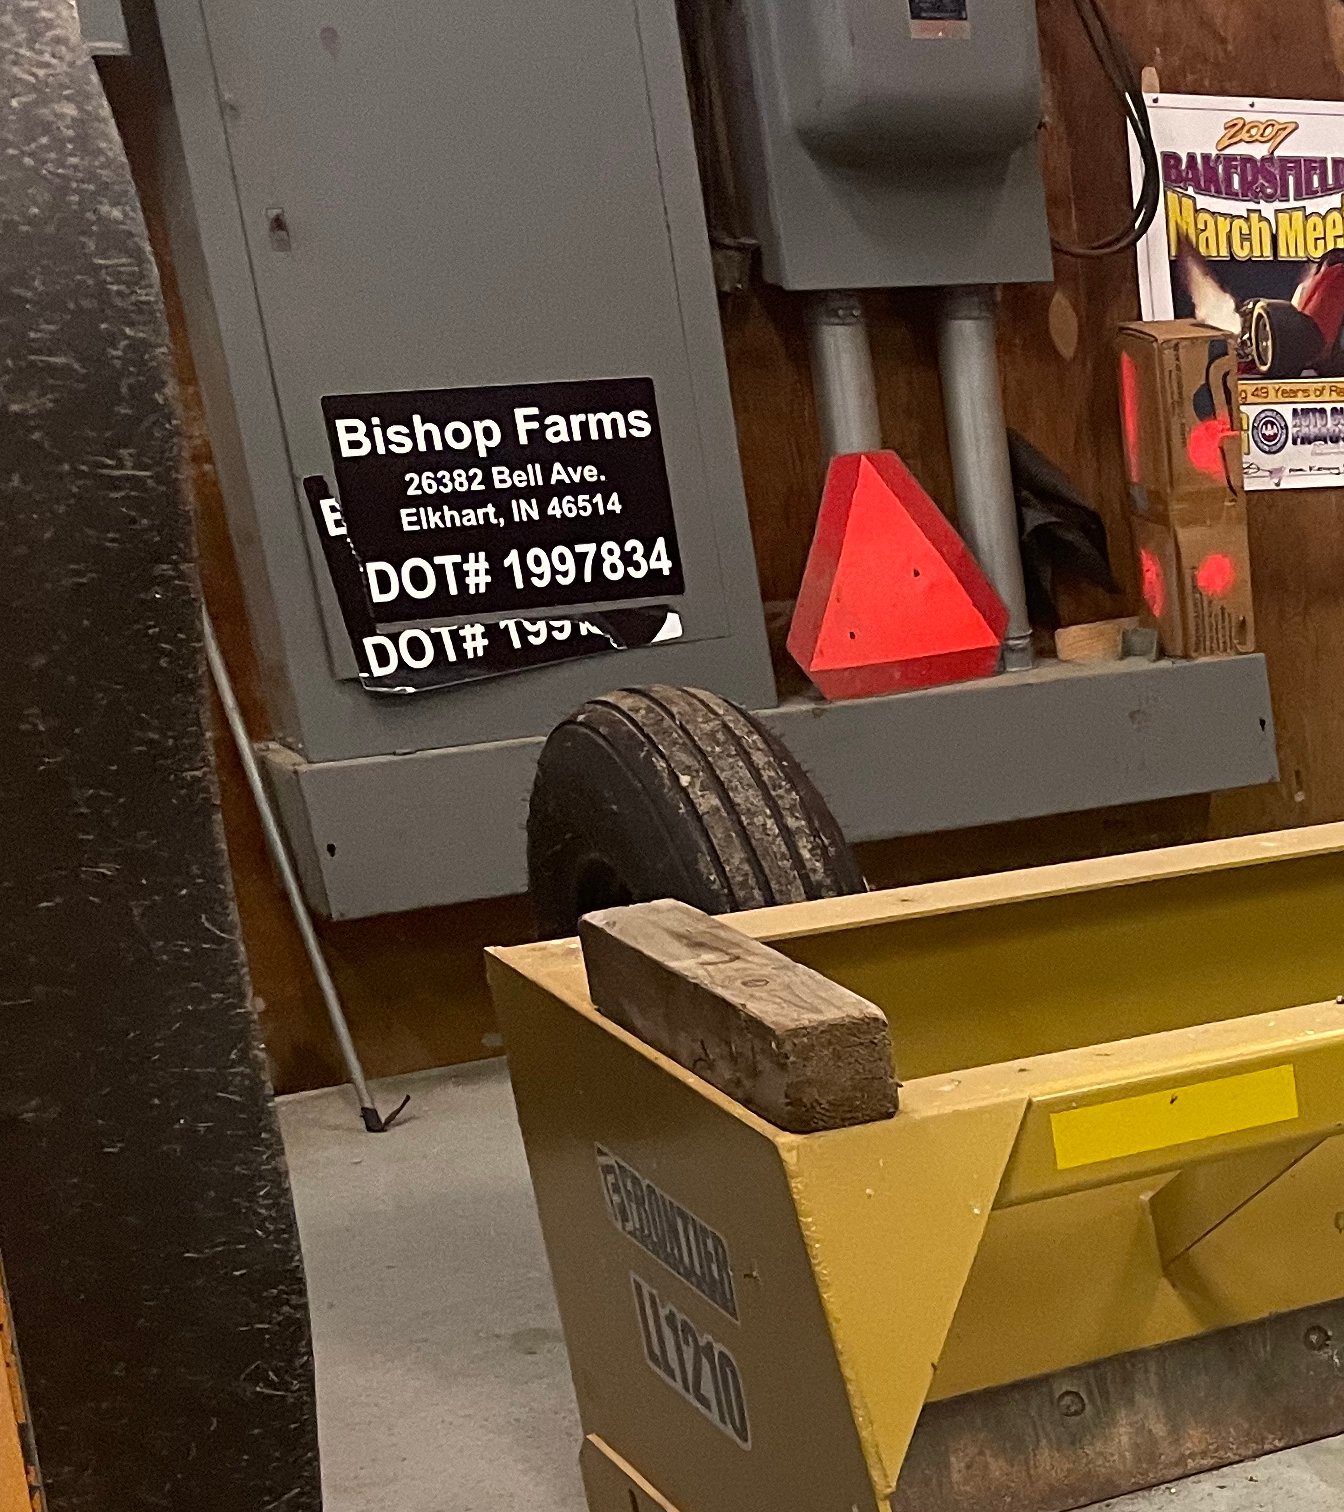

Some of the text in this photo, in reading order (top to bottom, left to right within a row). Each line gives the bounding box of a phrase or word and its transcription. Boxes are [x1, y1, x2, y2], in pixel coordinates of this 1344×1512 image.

[1216, 117, 1299, 154] 2007
[1165, 188, 1273, 261] March
[1251, 386, 1269, 399] 49
[1273, 386, 1310, 399] Years
[1314, 385, 1326, 398] of
[335, 406, 652, 458] Bishop Farms
[404, 462, 606, 496] 26382 Bell Ave.
[399, 492, 622, 531] Elkhart, IN 46514
[365, 536, 672, 604] DOT# 1997834
[362, 623, 489, 678] DOT#
[632, 1275, 749, 1444] LL1210
